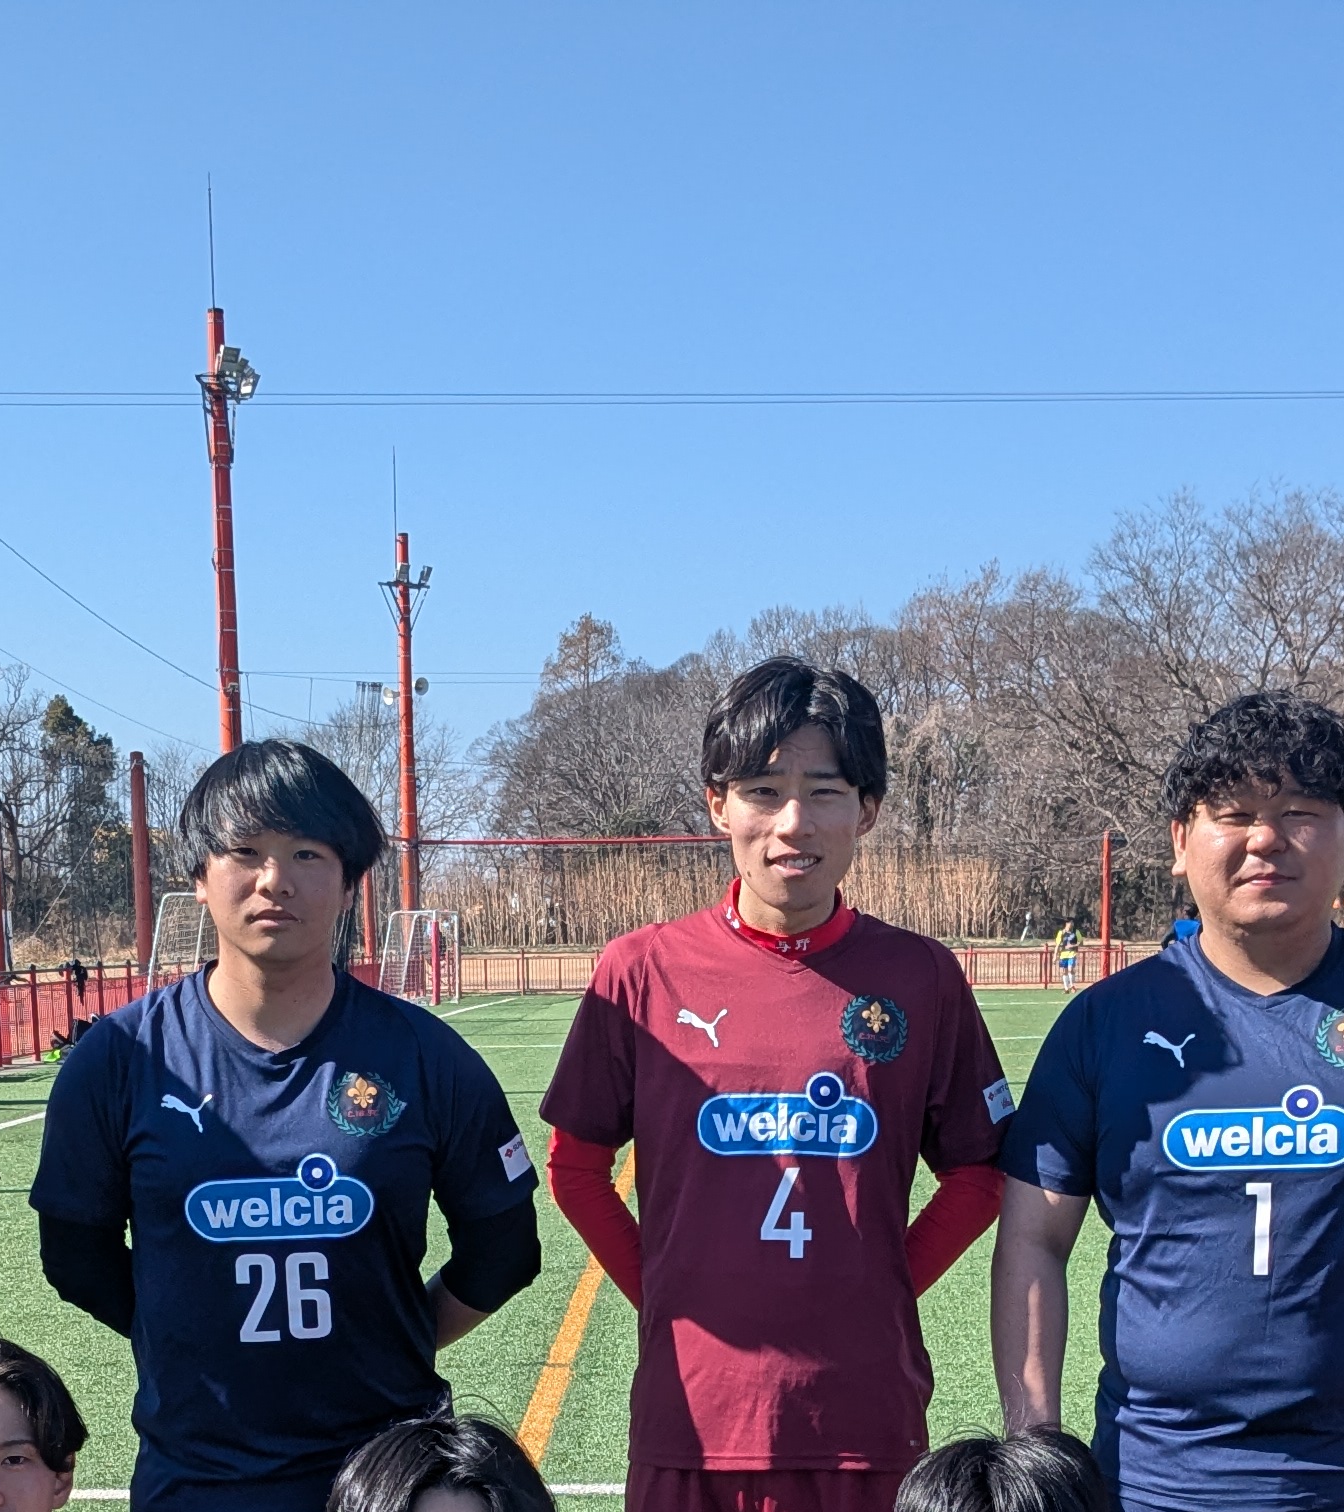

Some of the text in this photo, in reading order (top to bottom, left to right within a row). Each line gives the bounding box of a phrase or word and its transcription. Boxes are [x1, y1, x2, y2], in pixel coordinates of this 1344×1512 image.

[712, 1102, 858, 1145] welcia
[1181, 1116, 1339, 1158] welcia
[200, 1187, 354, 1229] welcia
[760, 1167, 813, 1259] 4
[1246, 1182, 1272, 1276] 1
[235, 1251, 332, 1343] 26
